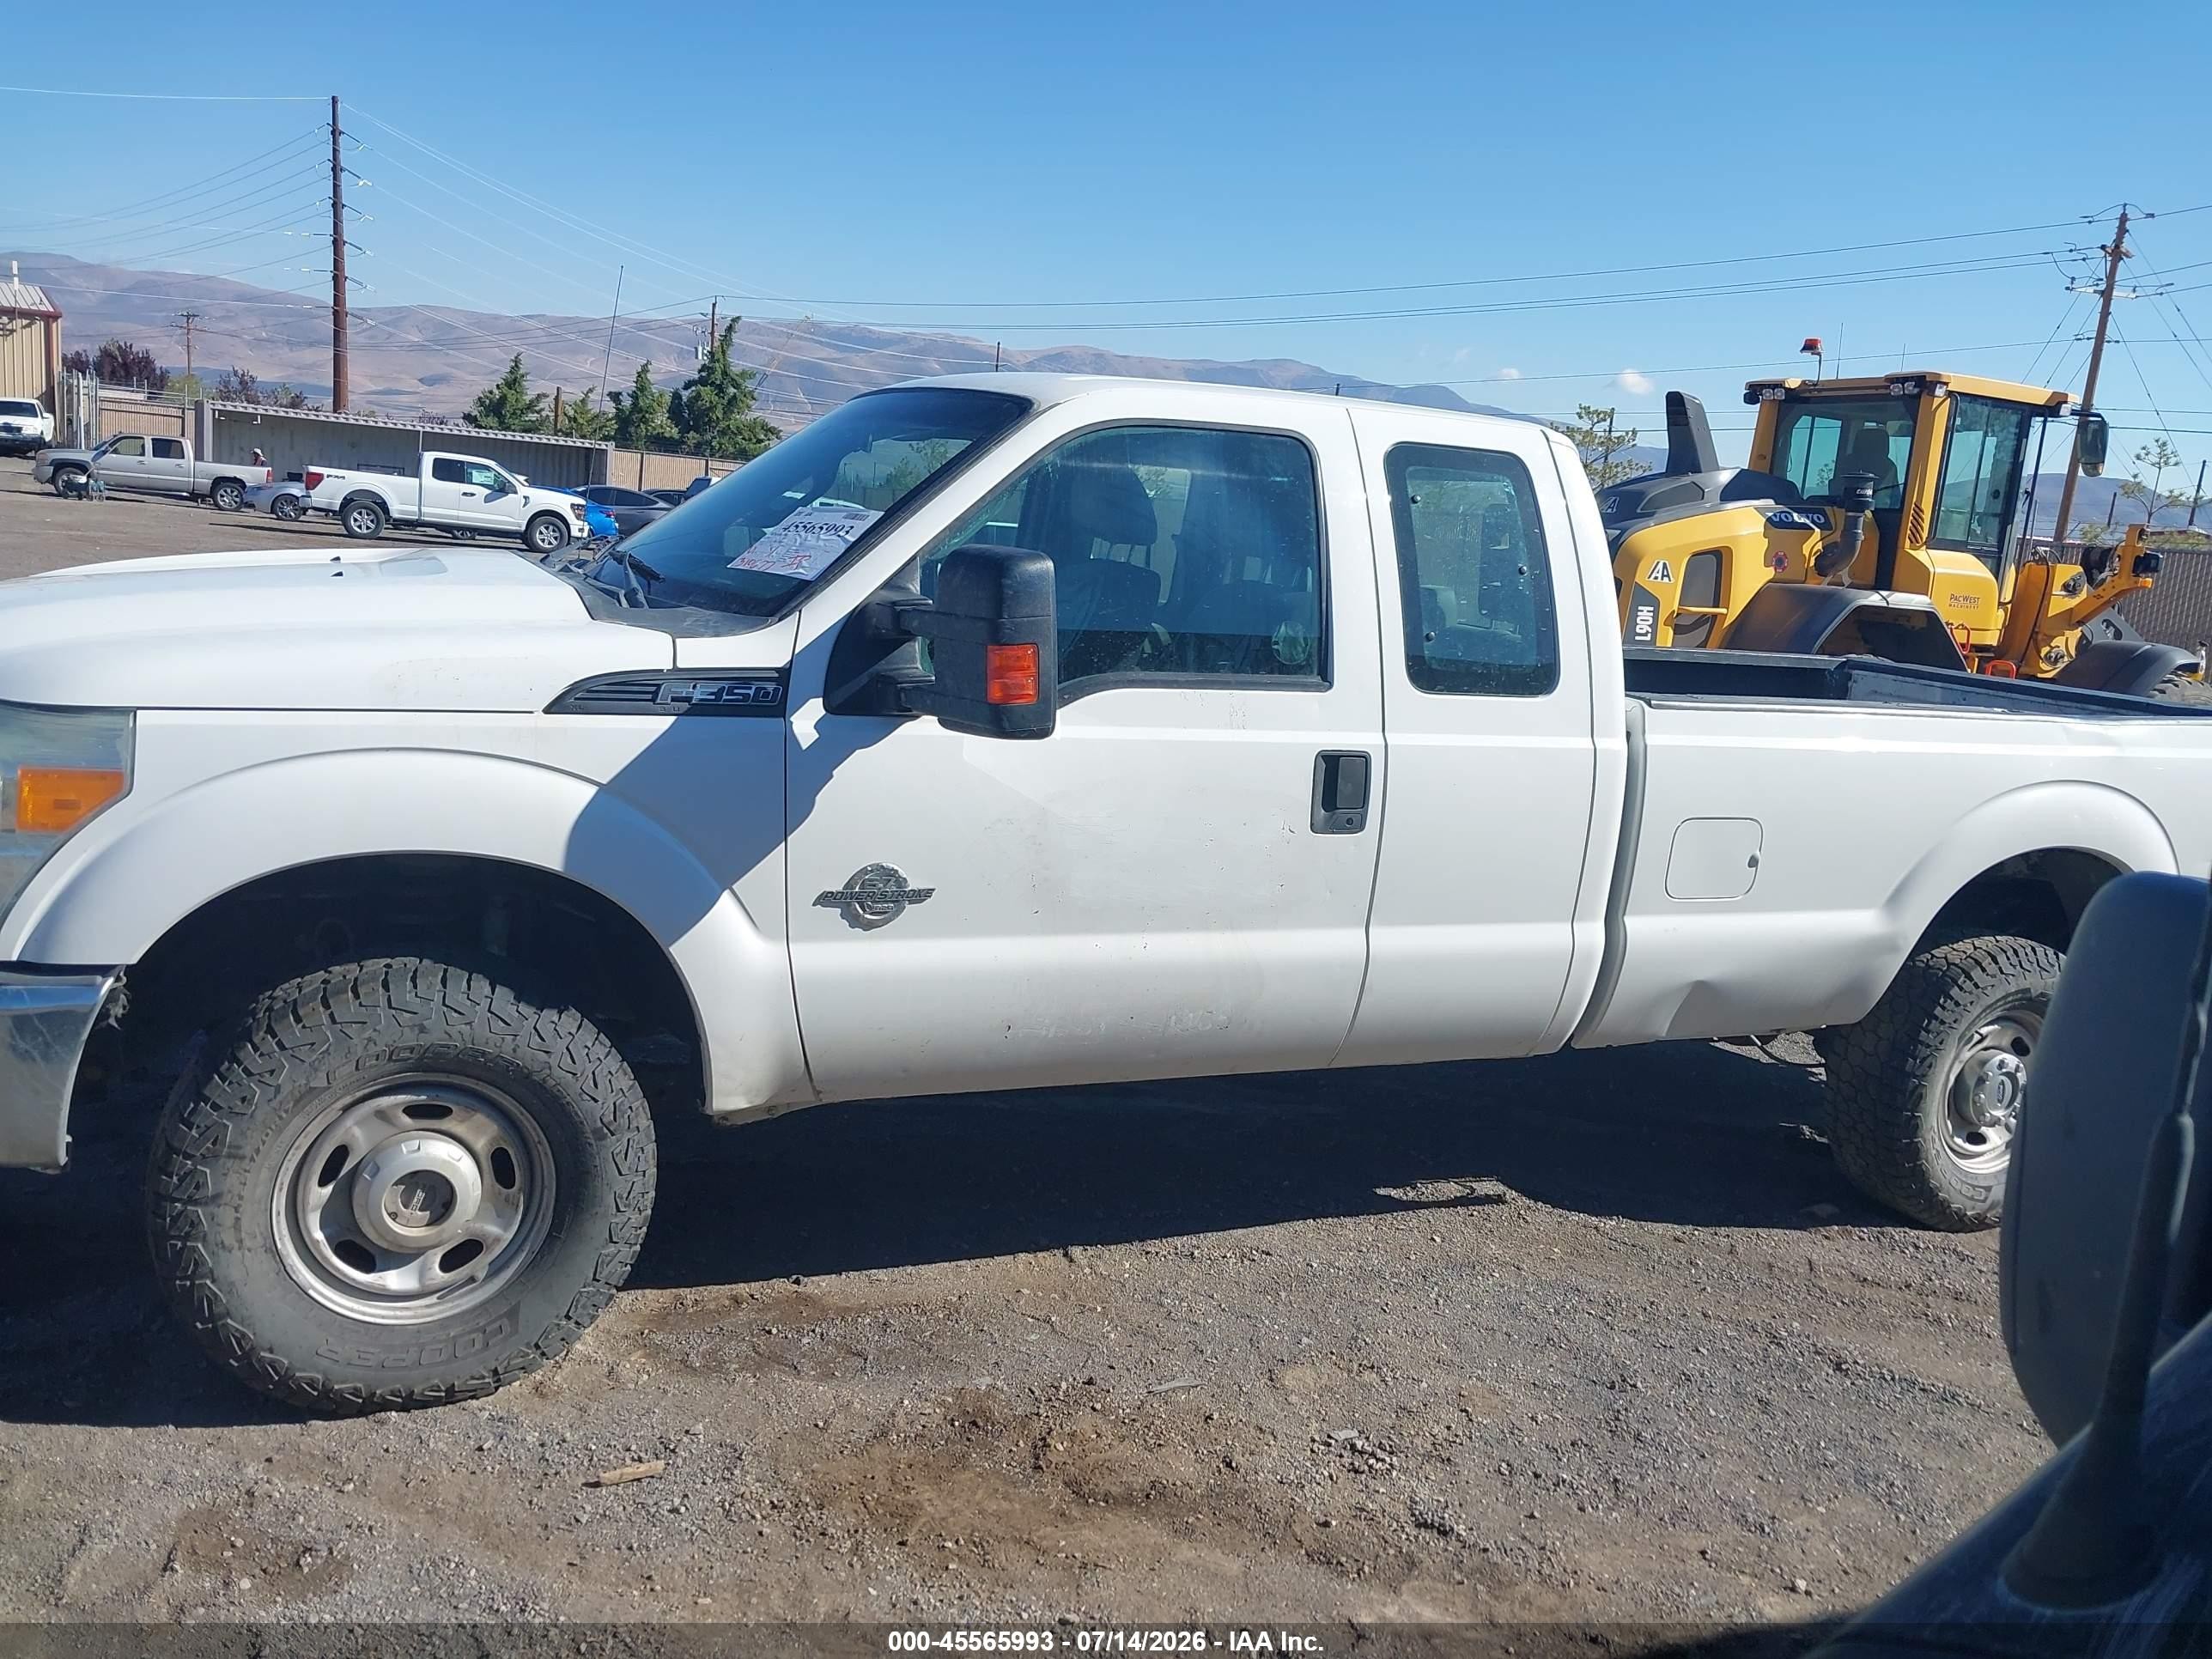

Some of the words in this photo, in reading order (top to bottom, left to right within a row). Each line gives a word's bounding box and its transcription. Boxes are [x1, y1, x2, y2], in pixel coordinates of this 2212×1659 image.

[781, 521, 855, 537] 45565993
[1765, 512, 1826, 524] VOLVO
[1634, 605, 1655, 641] L90H
[654, 682, 783, 705] F-350
[325, 1041, 524, 1084] COOPER
[316, 1317, 512, 1368] COOPER
